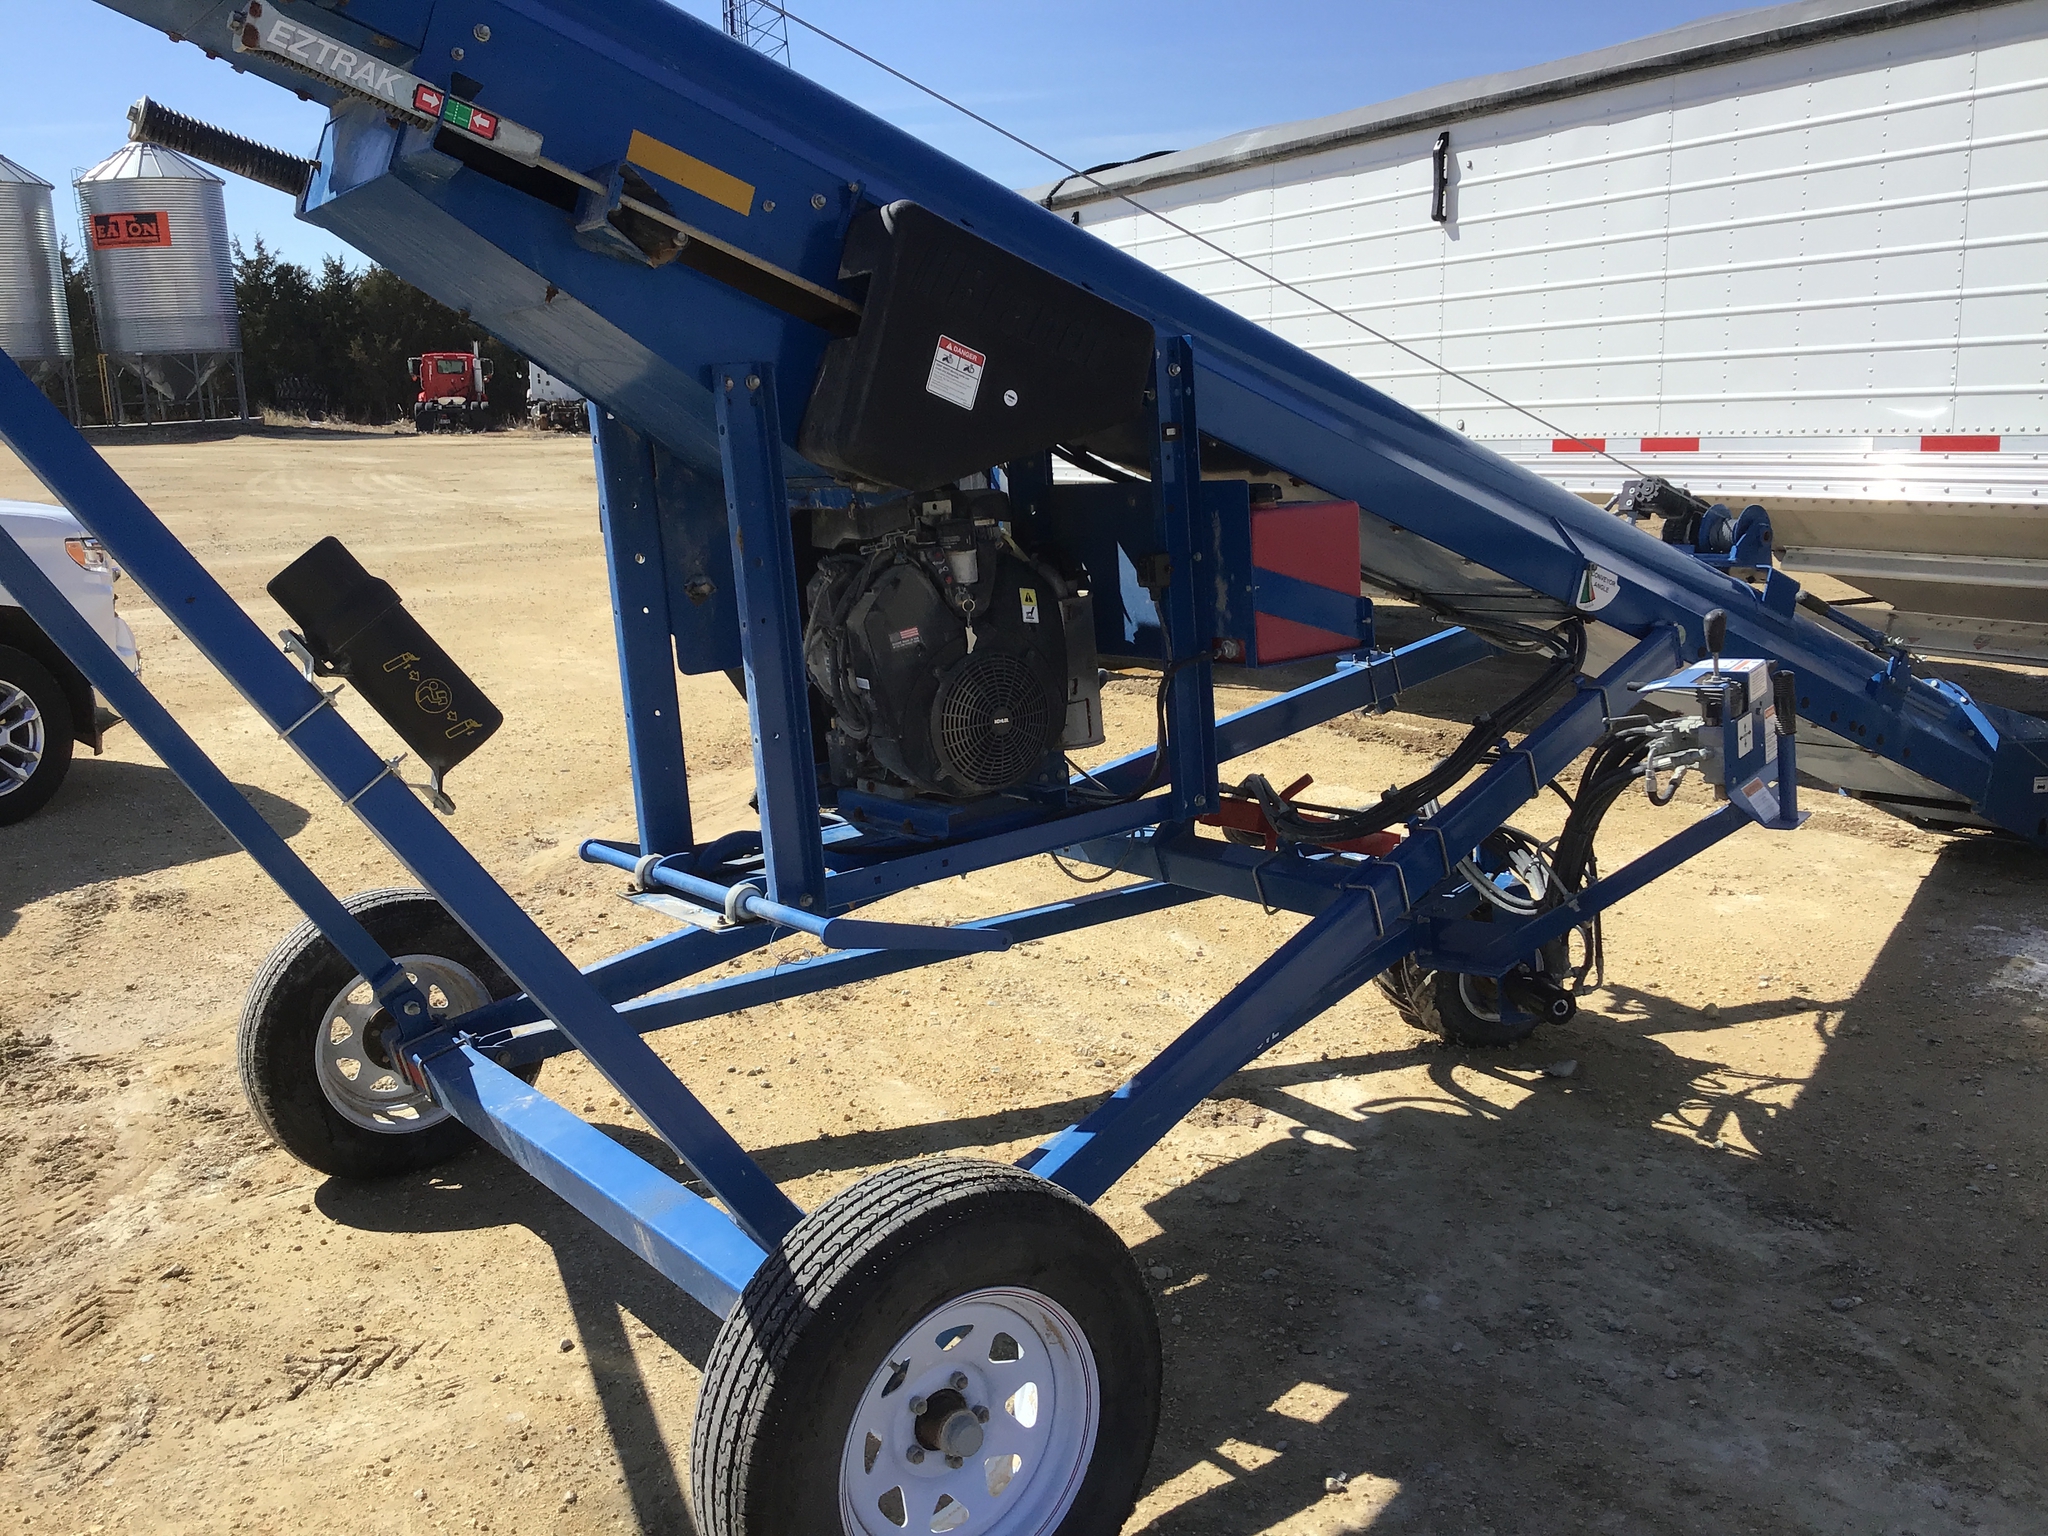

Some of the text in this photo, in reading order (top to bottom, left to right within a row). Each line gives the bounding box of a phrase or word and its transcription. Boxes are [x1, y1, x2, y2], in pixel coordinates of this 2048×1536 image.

[266, 19, 403, 98] EZTRAK
[96, 215, 158, 241] EATON
[953, 345, 978, 362] DANGER
[1593, 582, 1609, 593] ANGLE
